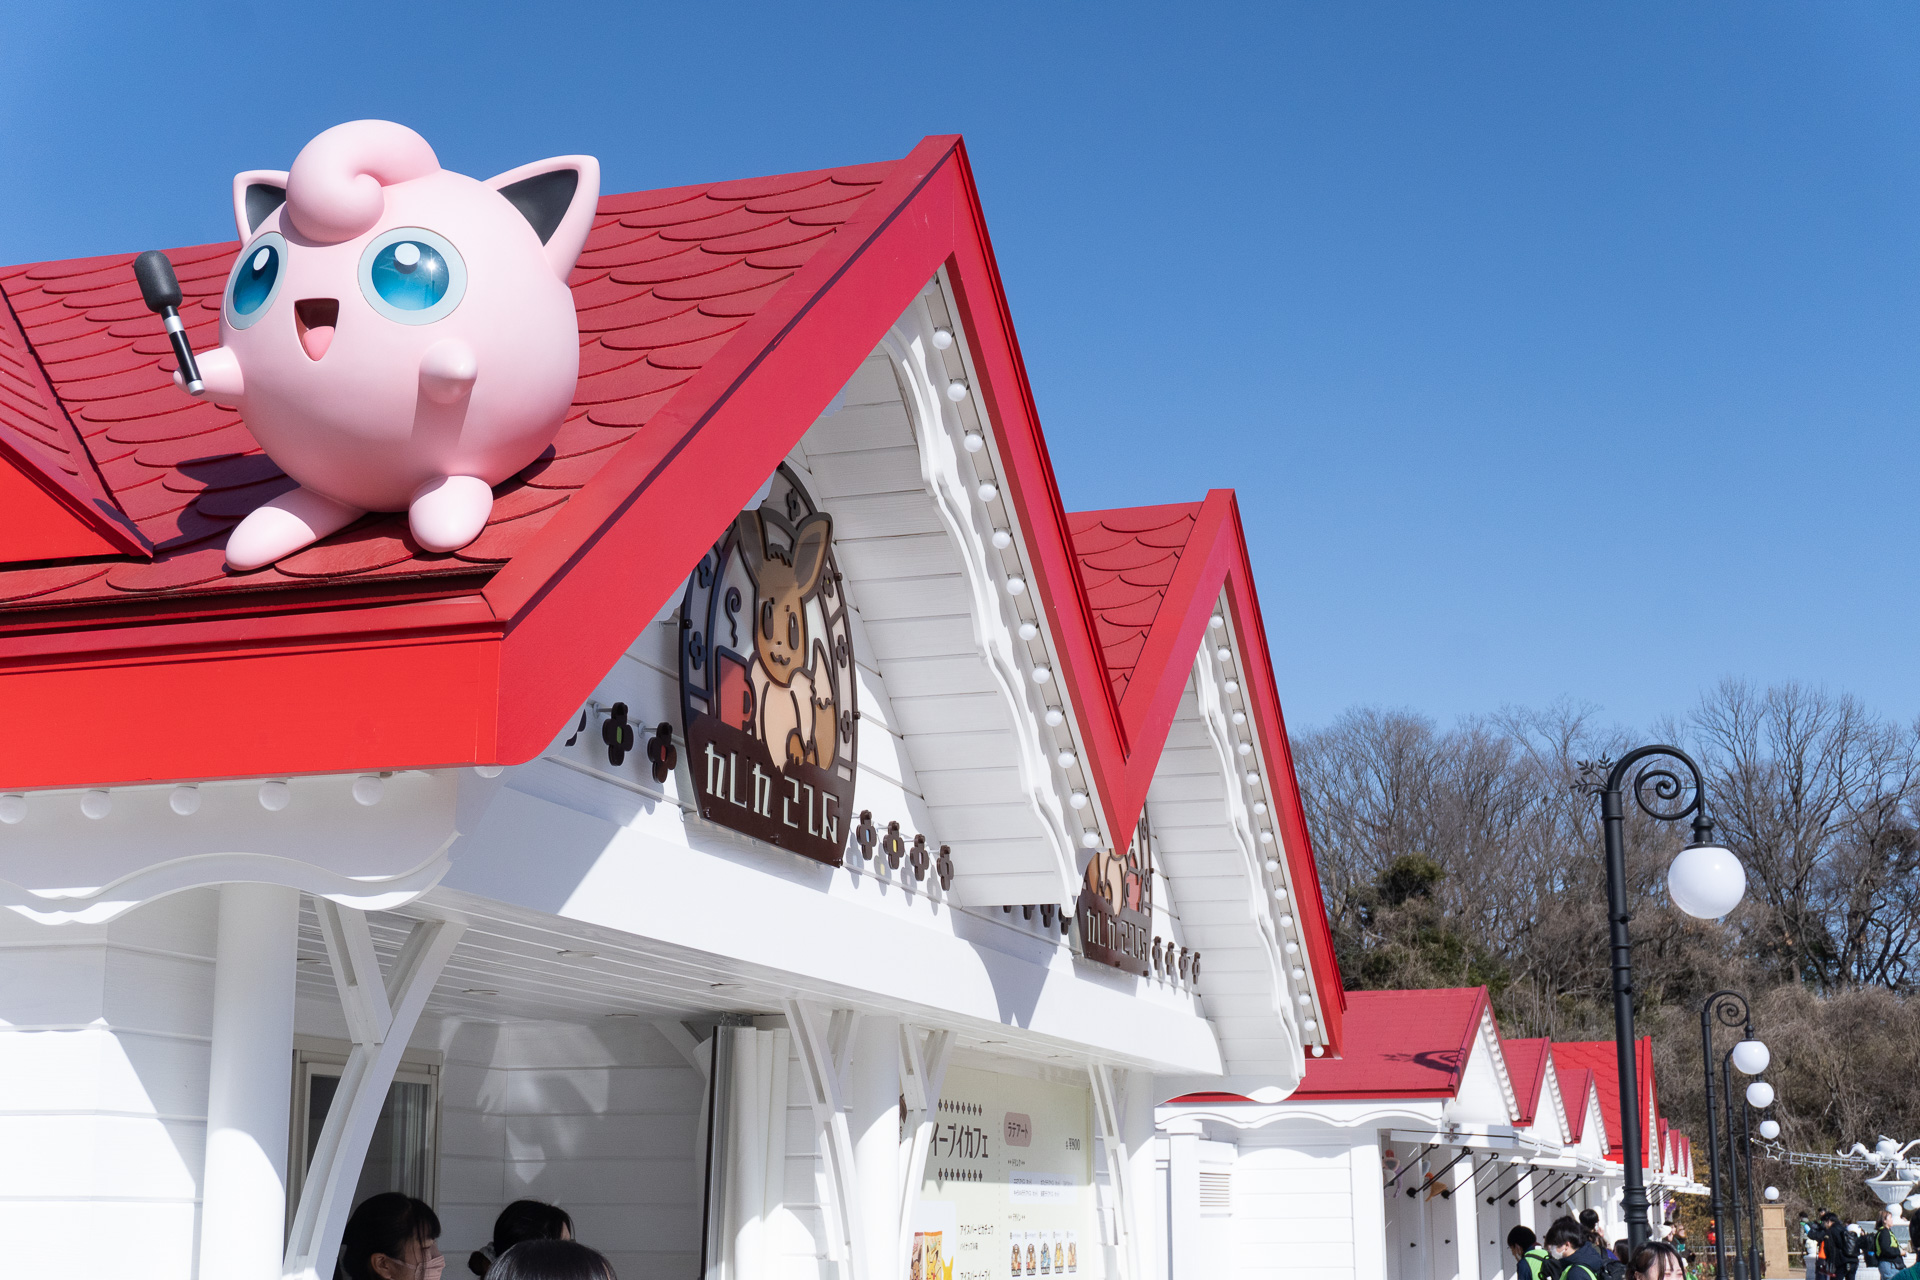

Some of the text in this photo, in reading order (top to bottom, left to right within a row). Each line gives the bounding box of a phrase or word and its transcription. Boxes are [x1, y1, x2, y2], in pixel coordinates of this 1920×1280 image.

[931, 1122, 988, 1159] イーブイカフェ
[1007, 1121, 1029, 1139] ラテアート
